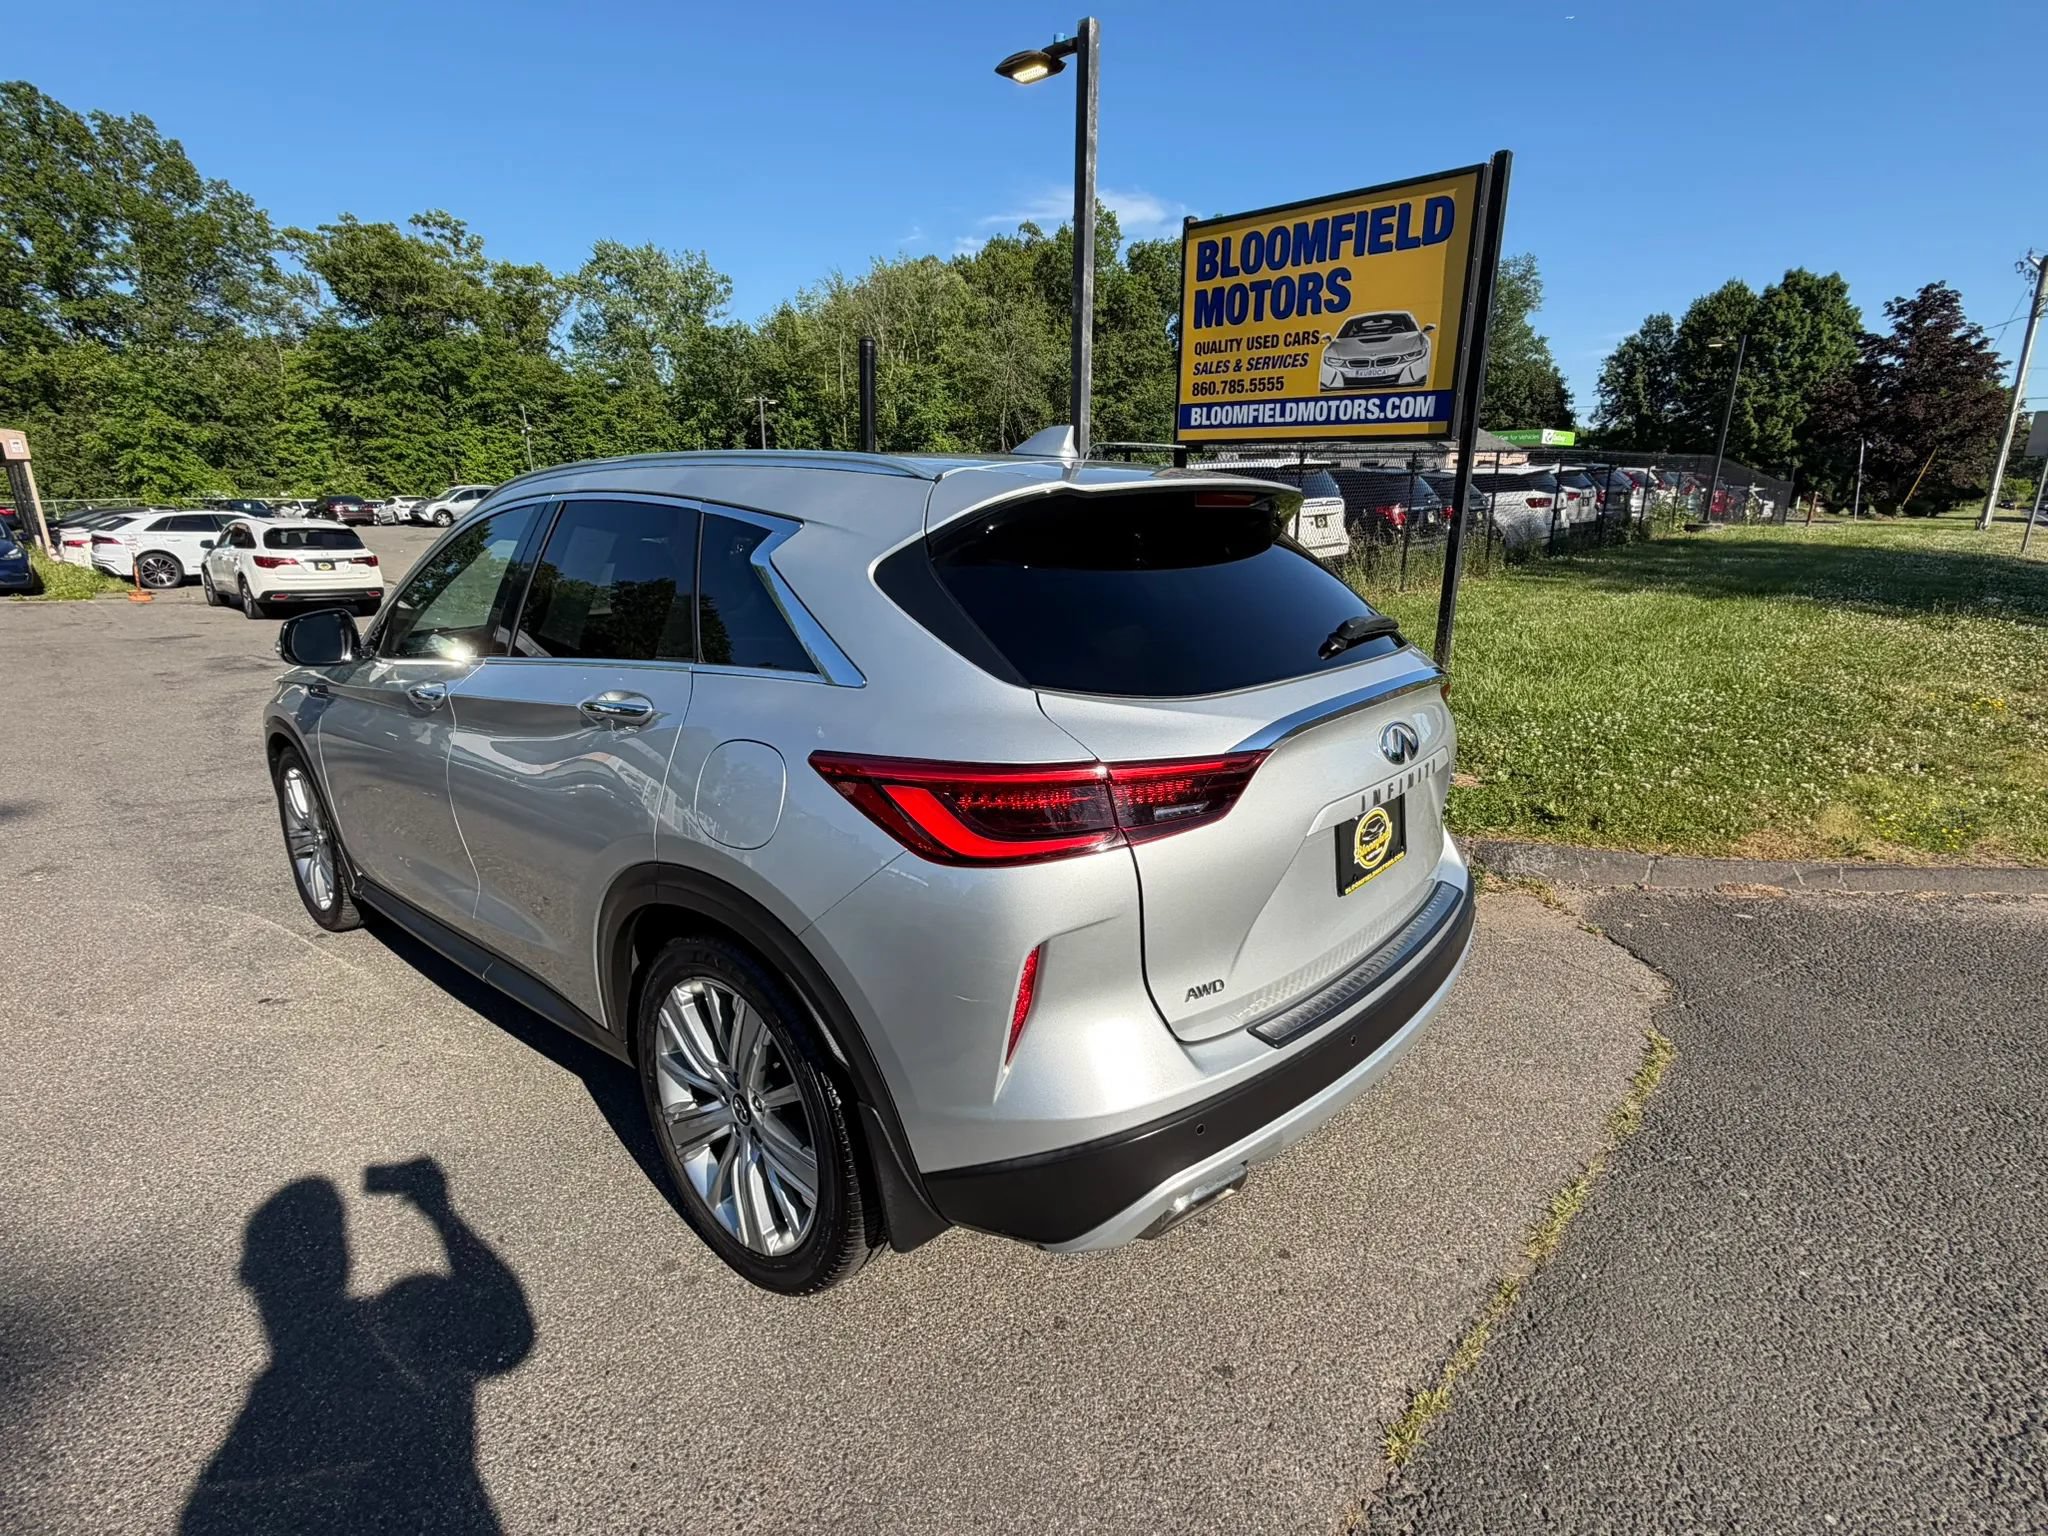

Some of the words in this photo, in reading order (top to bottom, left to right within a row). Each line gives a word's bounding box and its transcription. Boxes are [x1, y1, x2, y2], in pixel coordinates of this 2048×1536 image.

[1196, 195, 1455, 282] BLOOMFIELD
[1193, 267, 1352, 329] MOTORS
[1194, 337, 1243, 356] QUALITY
[1246, 334, 1280, 352] USED
[1283, 329, 1320, 348] CARS
[1193, 359, 1231, 376] SALES
[1233, 359, 1243, 373] &
[1246, 352, 1309, 372] SERVICES
[1192, 376, 1285, 397] 860.785.5555
[1190, 396, 1436, 427] BLOOMFIELDMOTORS.COM
[1361, 758, 1436, 812] INFINITI
[1184, 979, 1225, 1003] AWD
